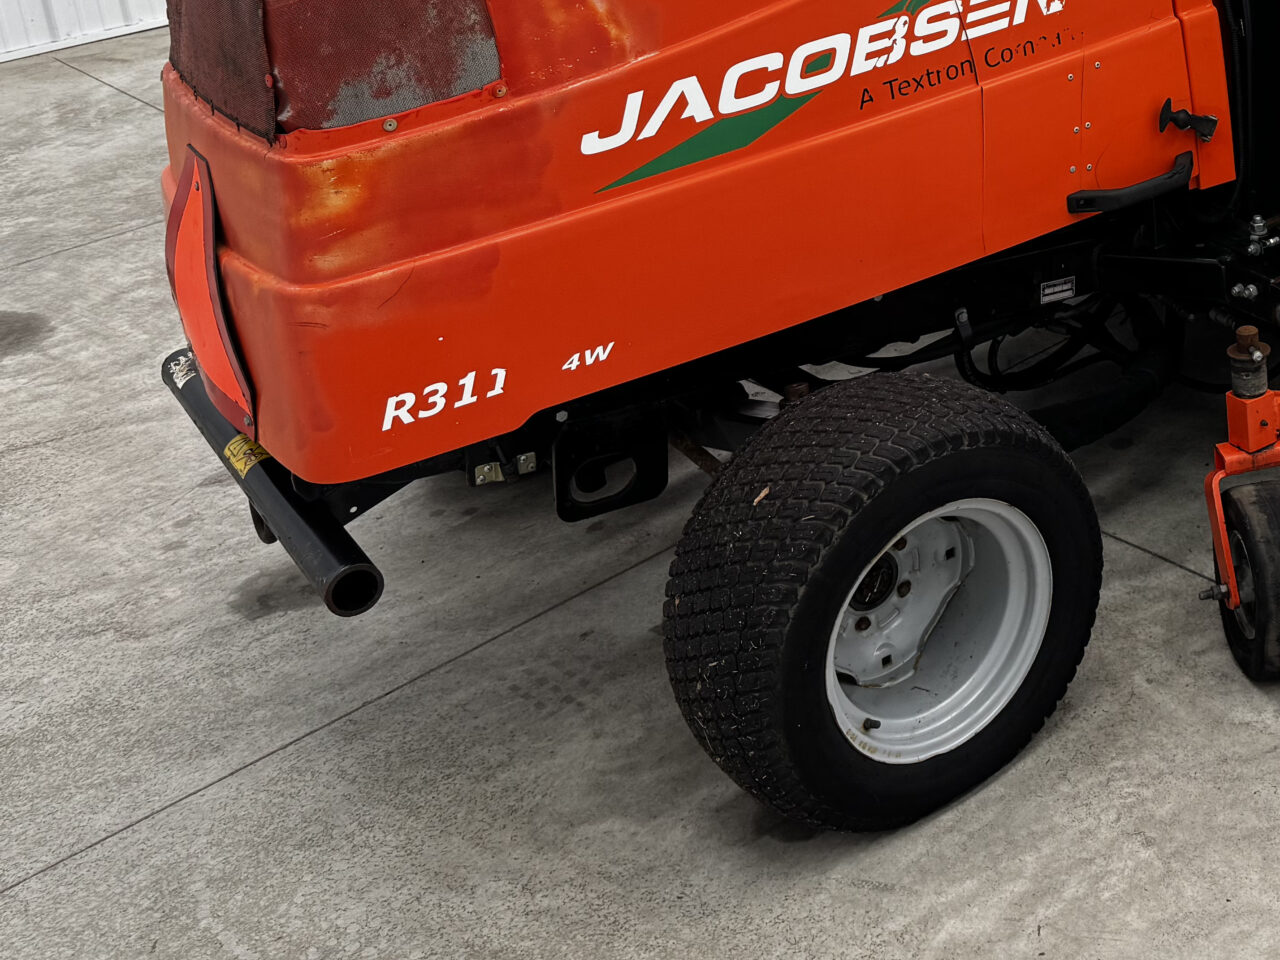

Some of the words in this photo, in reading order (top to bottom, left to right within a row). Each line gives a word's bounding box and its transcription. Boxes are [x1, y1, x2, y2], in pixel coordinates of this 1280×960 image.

[859, 88, 874, 110] A
[883, 58, 974, 100] Textron
[561, 341, 615, 371] 4W
